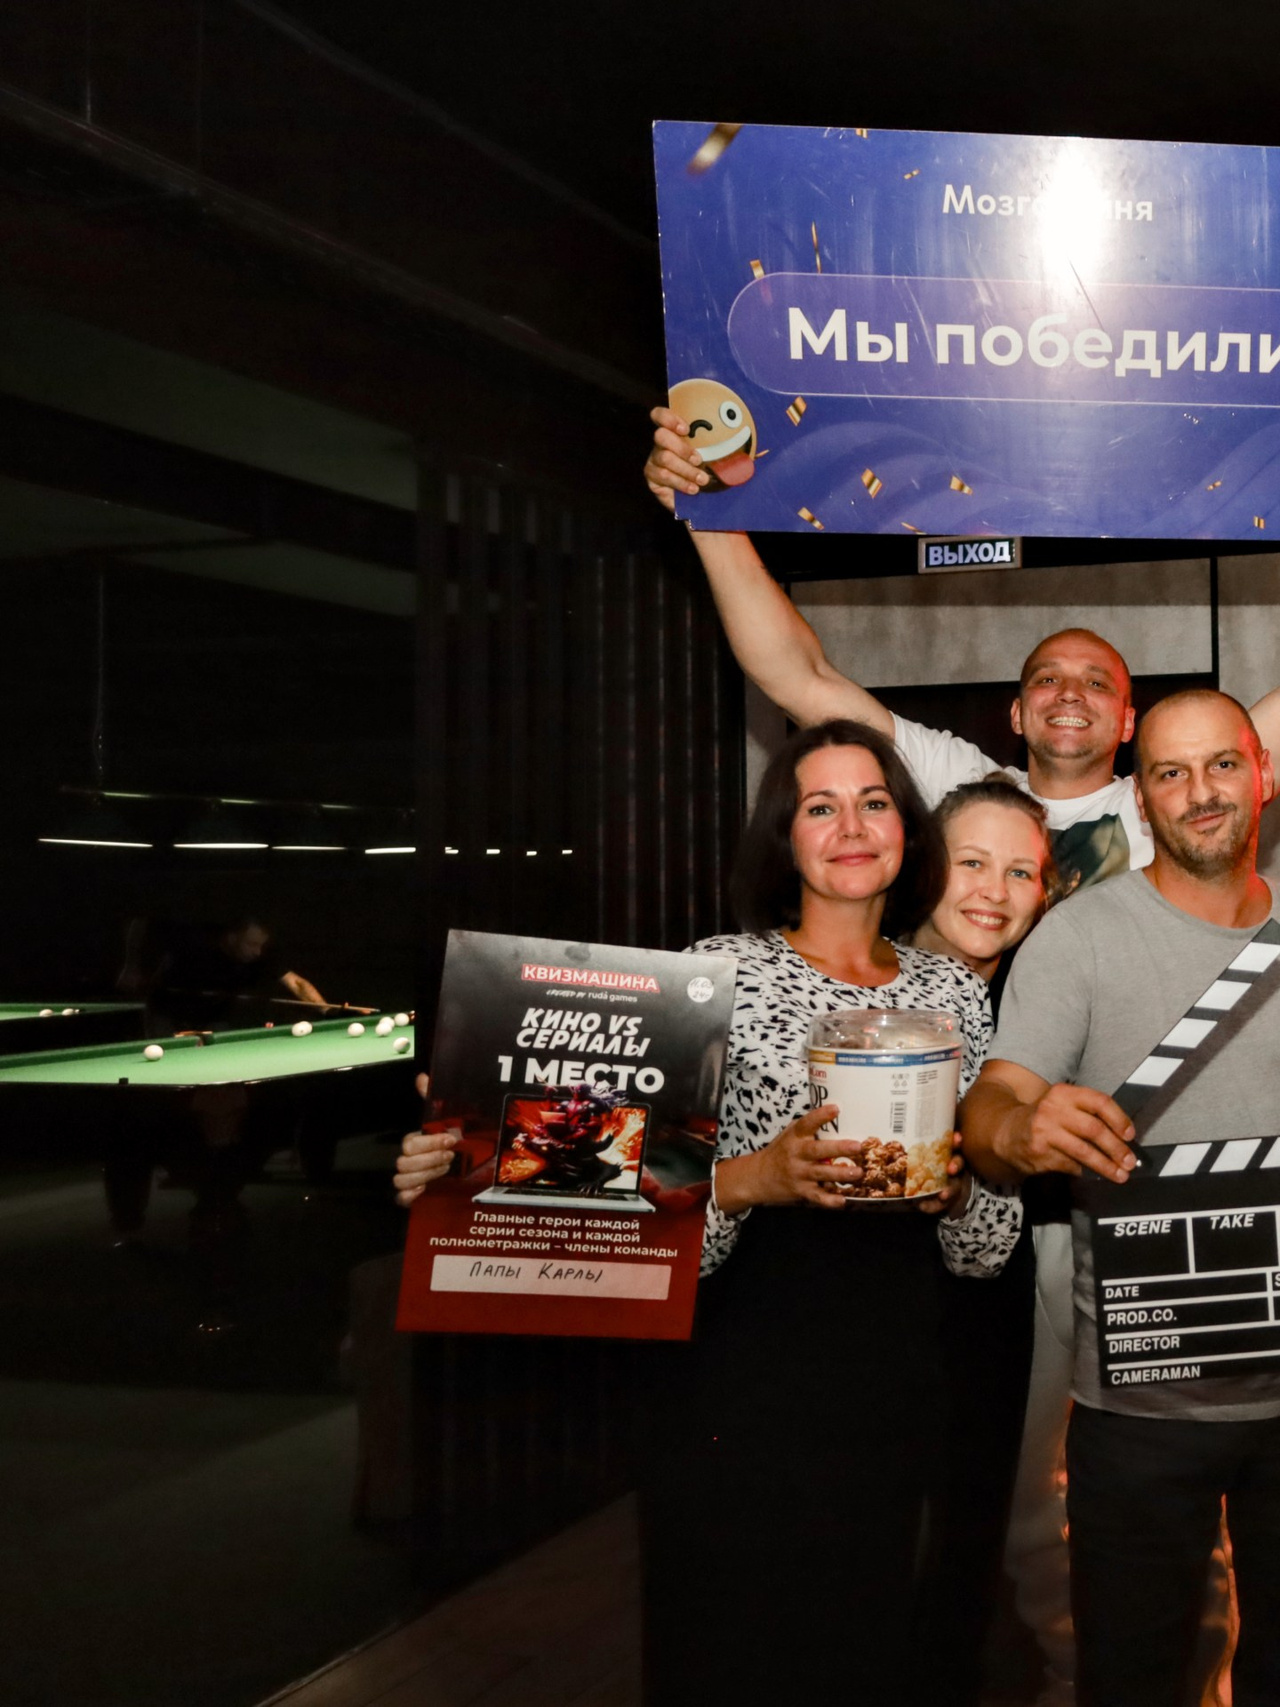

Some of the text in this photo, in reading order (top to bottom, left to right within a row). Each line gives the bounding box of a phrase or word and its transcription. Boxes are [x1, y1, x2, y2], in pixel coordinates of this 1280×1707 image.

[942, 184, 1153, 222] Мозгня
[788, 307, 909, 364] Мы
[929, 541, 1011, 566] ВЫХОД
[523, 965, 658, 991] КВИЗМАШИНА
[609, 994, 638, 1003] games
[521, 1007, 643, 1037] КИНО VS
[516, 1027, 651, 1058] СЕРИАЛЫ
[497, 1055, 665, 1095] 1 МЕСТО
[473, 1211, 641, 1231] Главные герои каждой
[1113, 1219, 1172, 1237] SCENE
[1210, 1213, 1255, 1230] TAKE
[469, 1225, 641, 1244] серии сезона и каждой
[429, 1237, 551, 1252] полнометражки
[564, 1242, 610, 1254] члены
[614, 1246, 678, 1259] команды
[1105, 1286, 1140, 1299] DATE
[1106, 1308, 1177, 1326] PROD.CO.
[1109, 1335, 1181, 1354] DIRECTOR
[1111, 1365, 1201, 1385] CAMERAMAN
